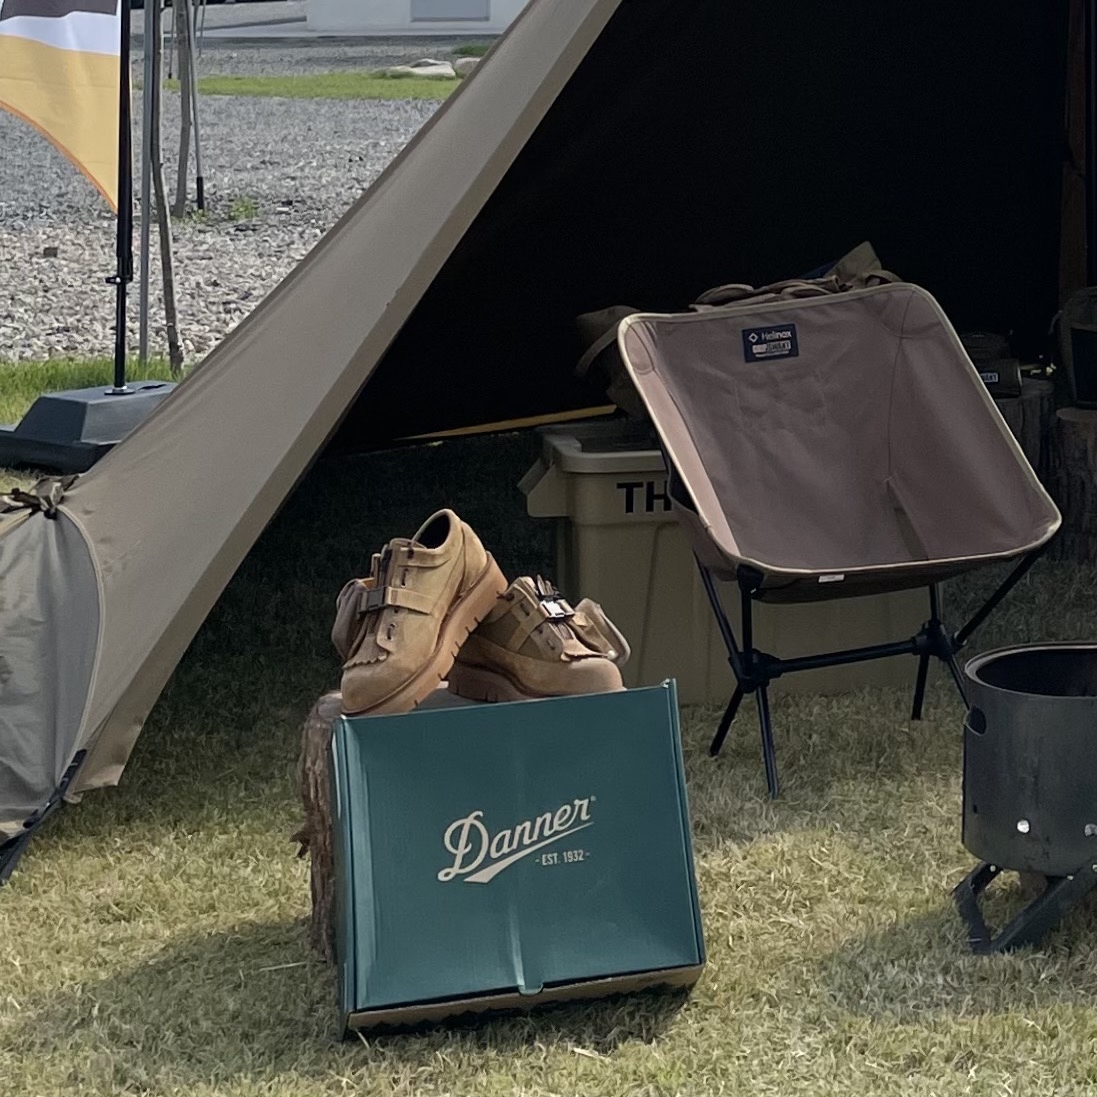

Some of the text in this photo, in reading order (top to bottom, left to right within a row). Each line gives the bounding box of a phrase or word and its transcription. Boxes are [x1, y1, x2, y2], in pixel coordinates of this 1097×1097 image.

[616, 482, 673, 514] TH
[438, 798, 593, 883] Danner
[563, 849, 585, 863] 1932
